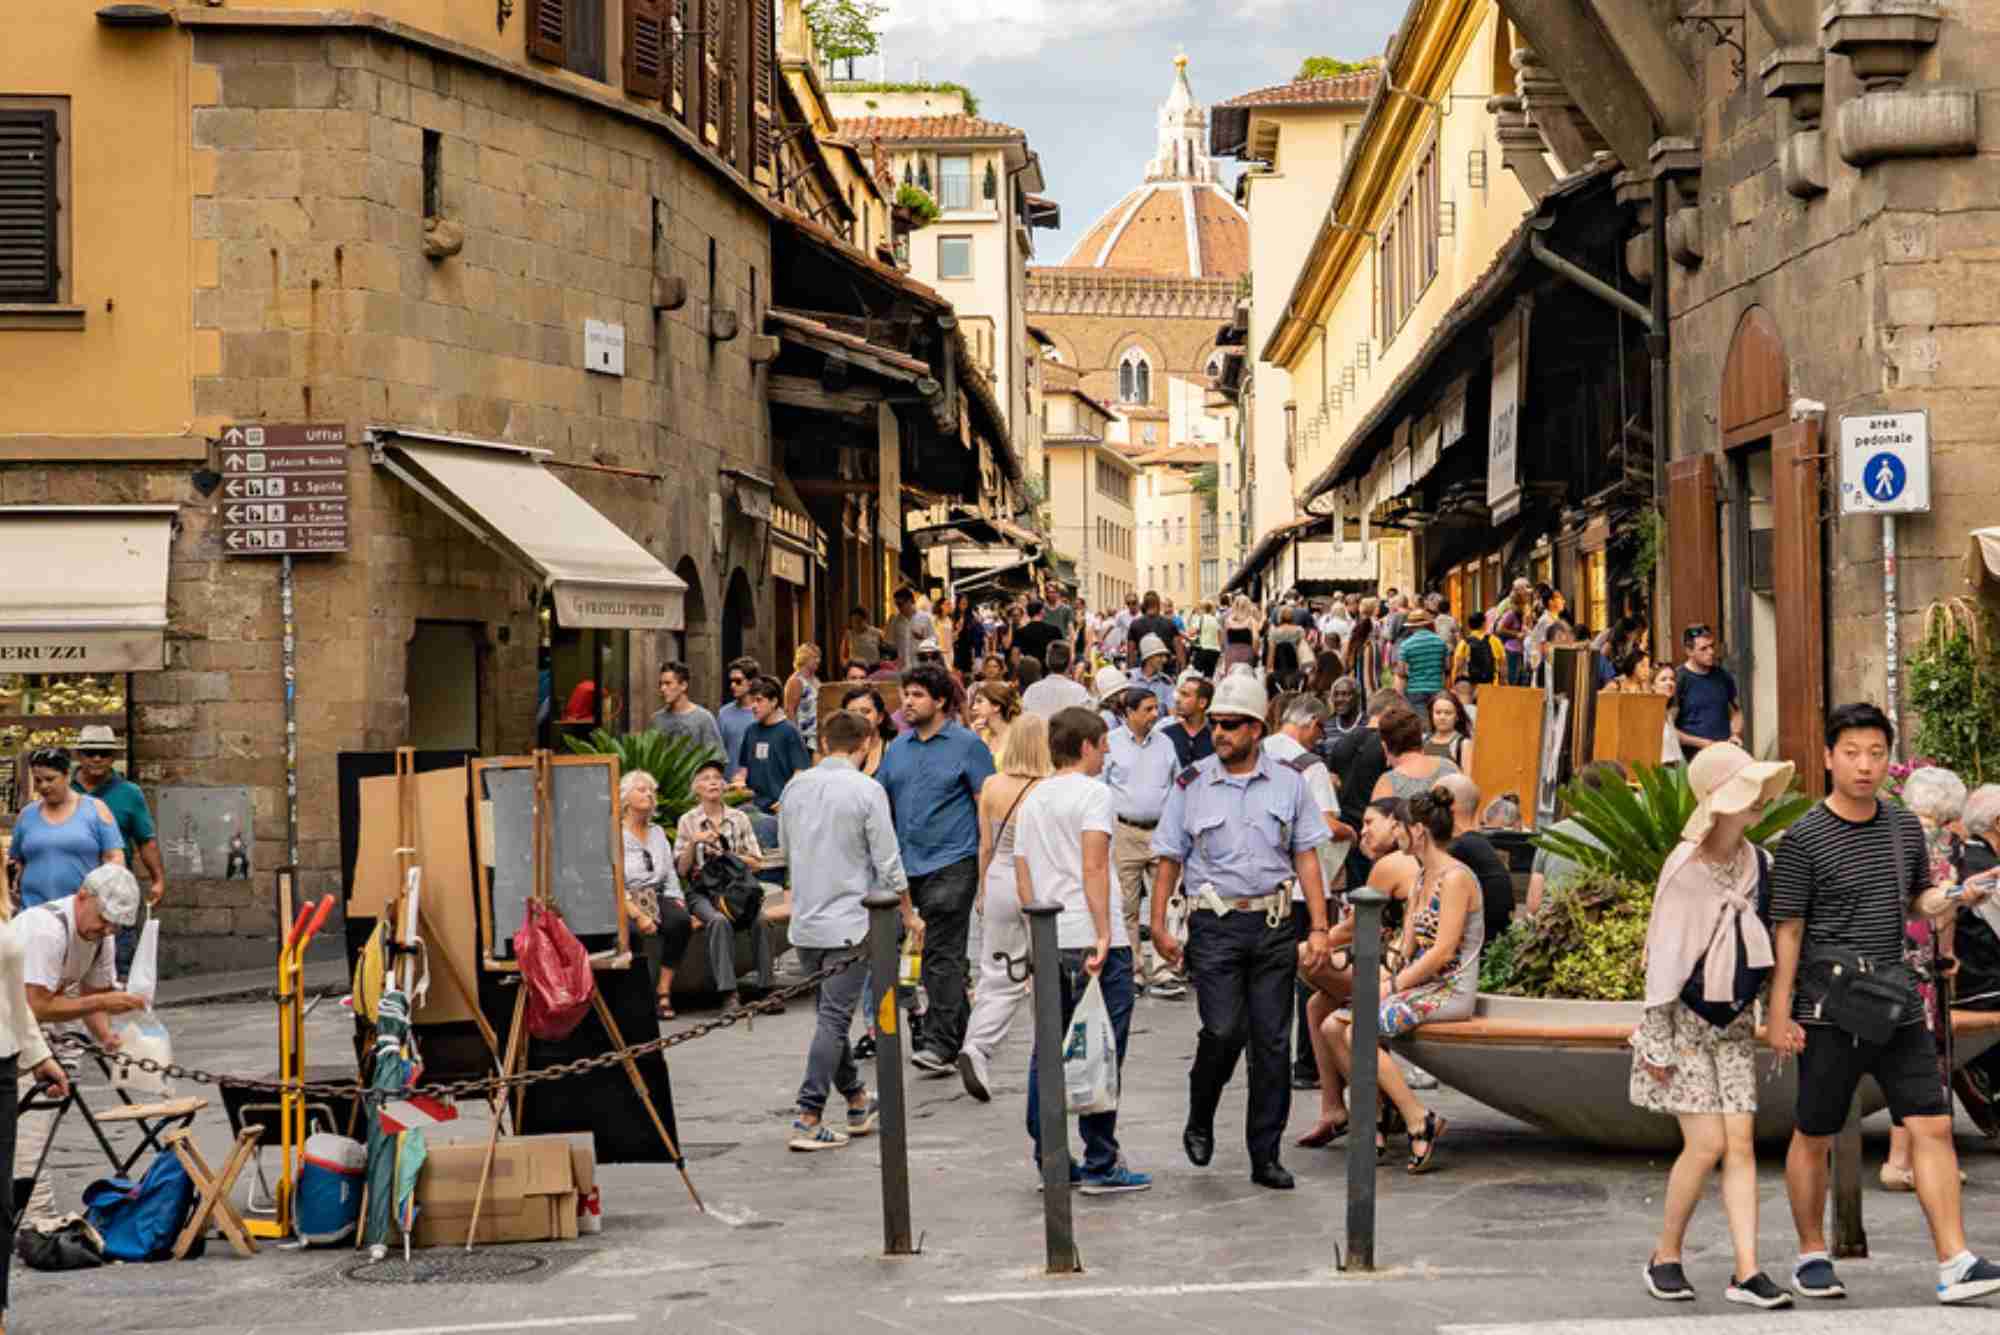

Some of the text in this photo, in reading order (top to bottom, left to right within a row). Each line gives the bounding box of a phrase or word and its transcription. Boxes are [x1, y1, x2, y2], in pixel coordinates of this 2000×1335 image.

[1870, 420, 1897, 429] area
[306, 430, 343, 440] Uffizi
[1855, 433, 1913, 448] pedonale
[307, 481, 343, 494] Spirito
